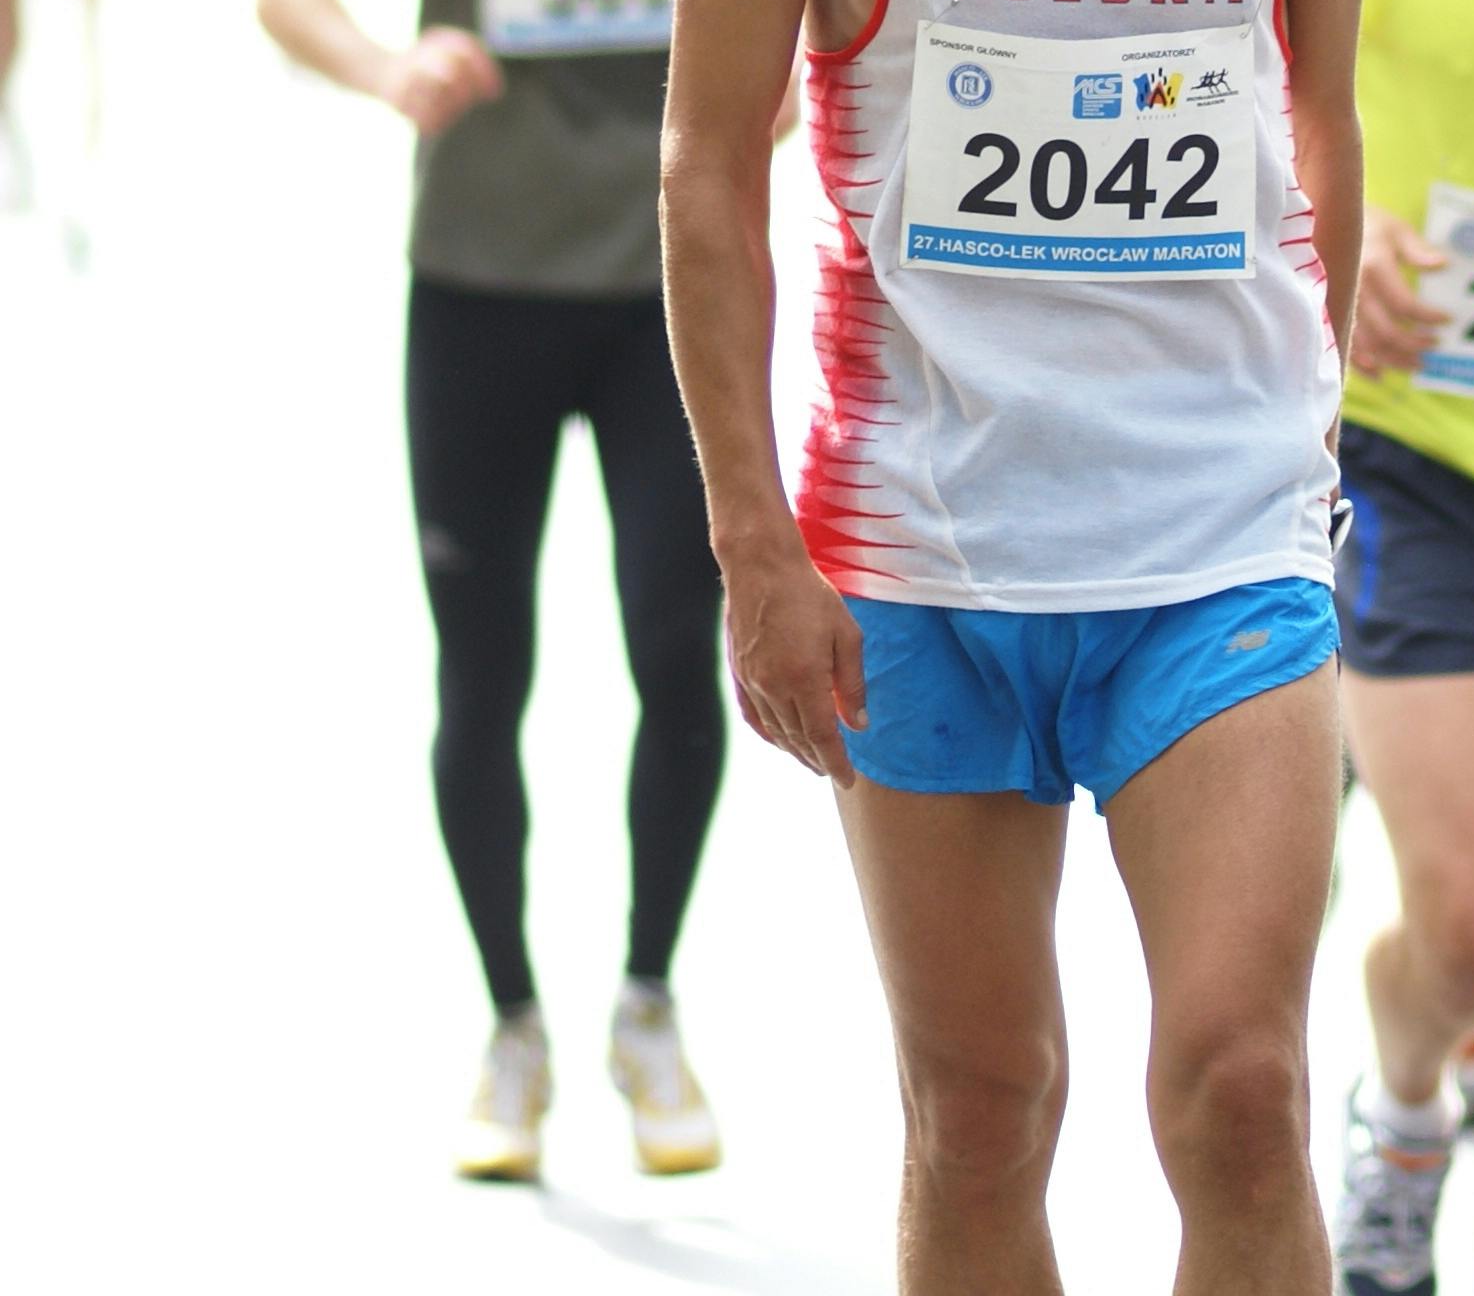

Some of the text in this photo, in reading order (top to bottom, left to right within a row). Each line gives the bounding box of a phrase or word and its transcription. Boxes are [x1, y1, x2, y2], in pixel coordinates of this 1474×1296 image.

[929, 37, 975, 53] SPONSOR
[1121, 47, 1196, 62] ORGANIZATORZY
[957, 132, 1220, 221] 2042
[1051, 246, 1149, 263] WROCŁAW
[1152, 242, 1242, 261] MARATON
